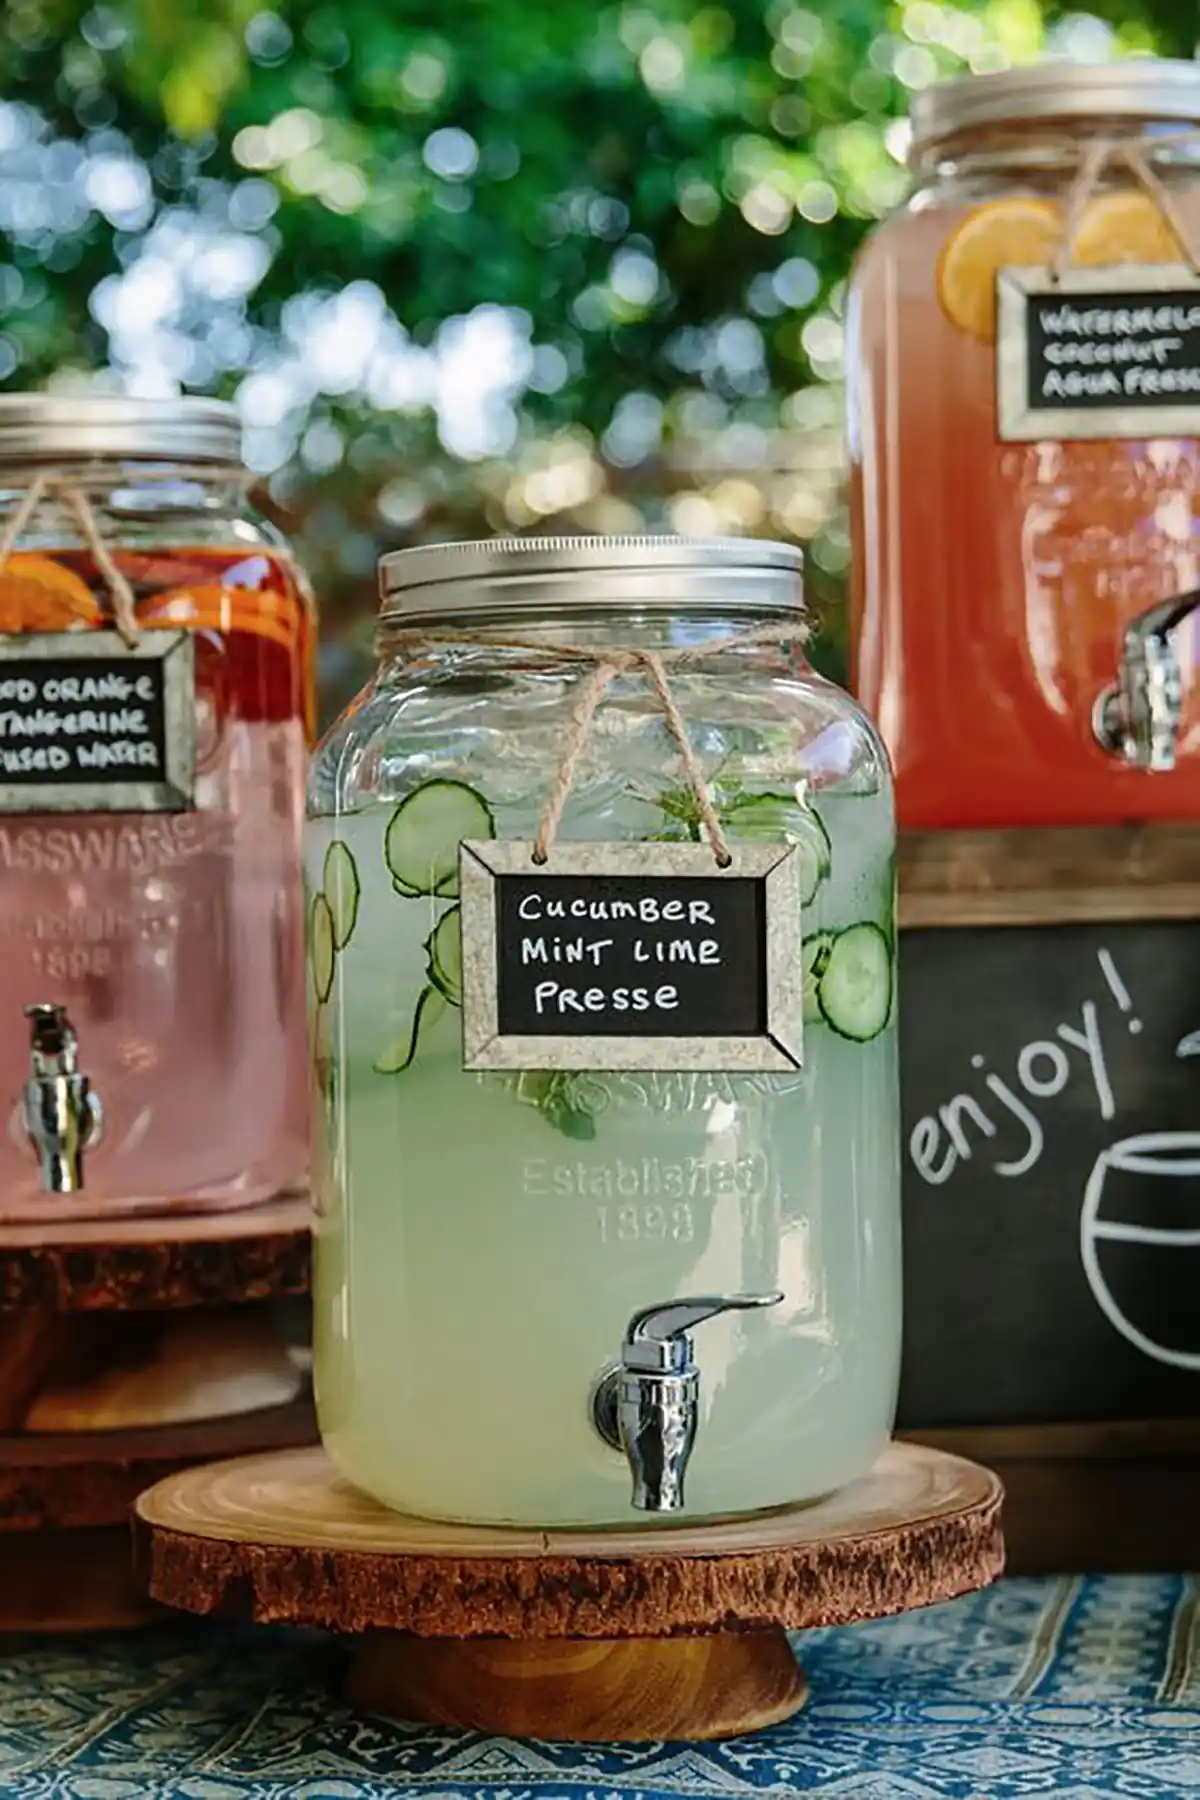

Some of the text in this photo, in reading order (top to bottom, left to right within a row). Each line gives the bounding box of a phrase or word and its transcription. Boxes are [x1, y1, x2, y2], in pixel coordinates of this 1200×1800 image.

[1043, 337, 1183, 365] COCONUT
[42, 672, 156, 703] ORANGE
[0, 746, 70, 773] USED
[910, 948, 1143, 1185] enjoy!
